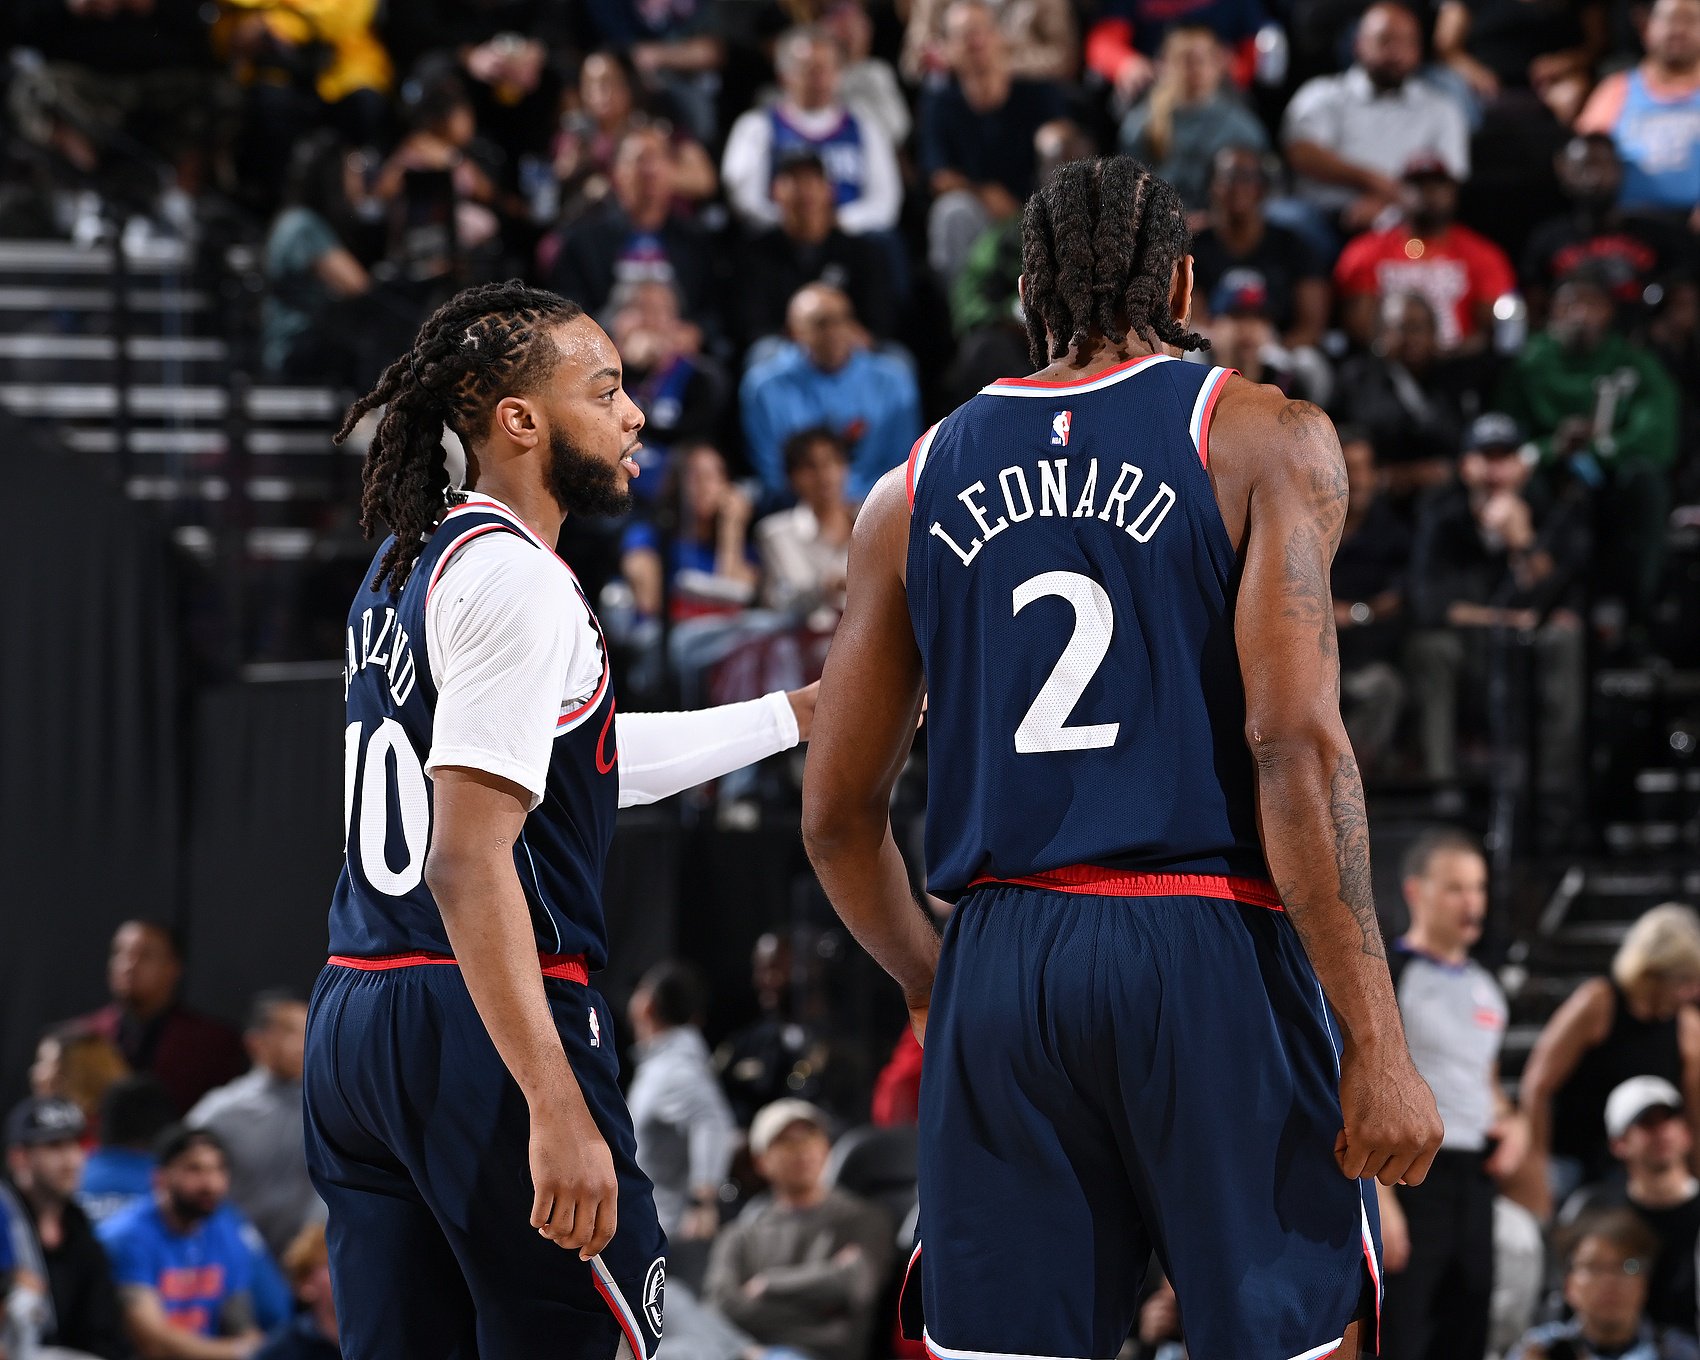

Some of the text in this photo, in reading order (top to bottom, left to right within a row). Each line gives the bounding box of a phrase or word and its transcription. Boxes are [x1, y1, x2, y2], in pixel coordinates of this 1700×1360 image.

[929, 457, 1176, 567] LEONARD
[1012, 570, 1121, 754] 2
[344, 716, 430, 896] 10
